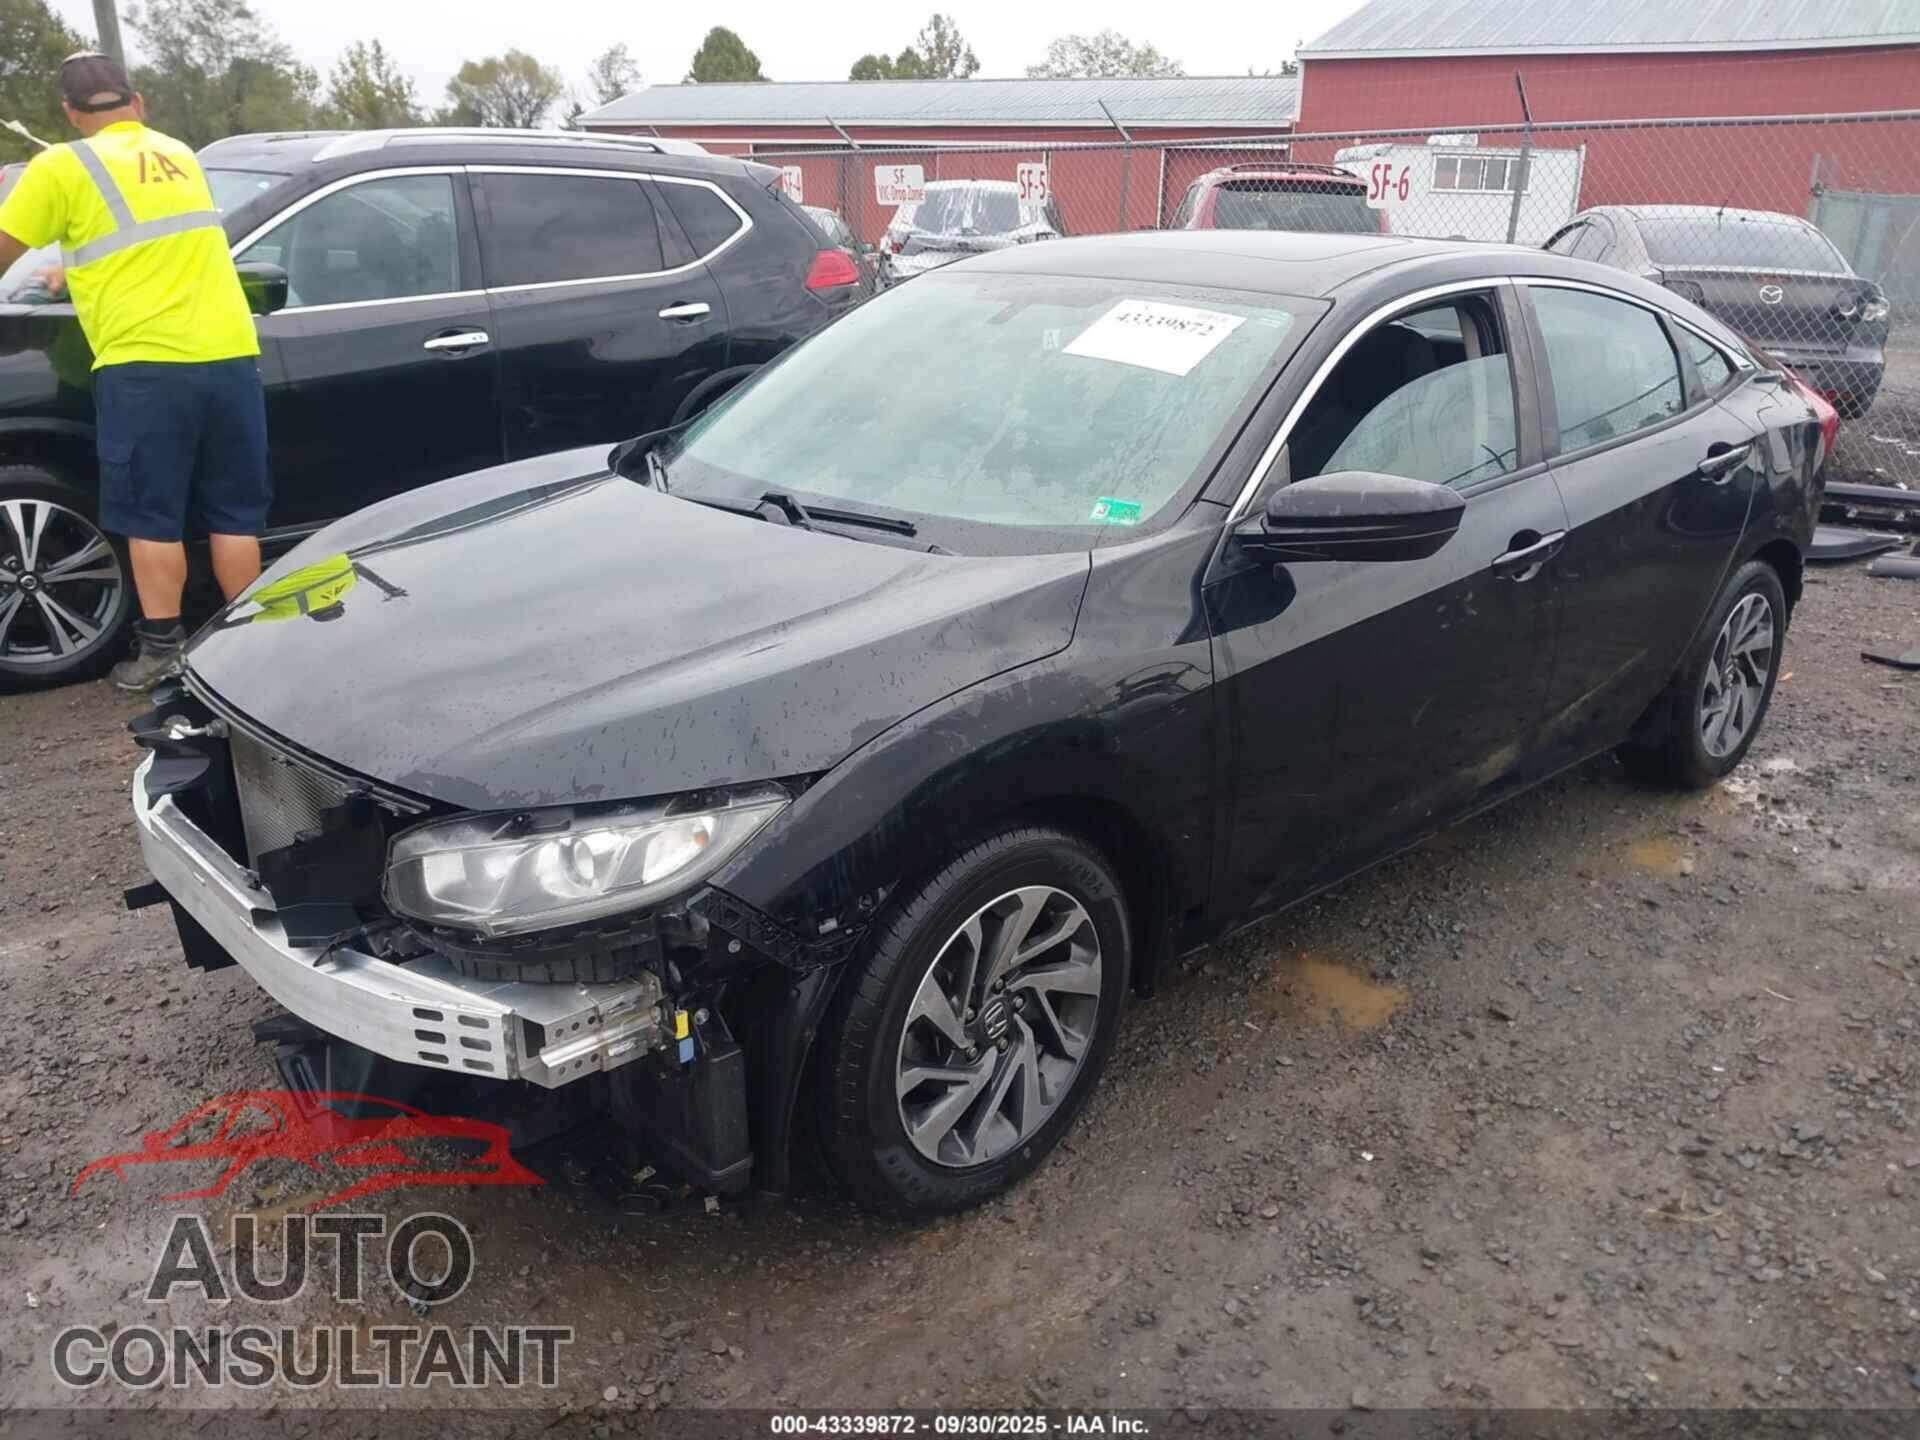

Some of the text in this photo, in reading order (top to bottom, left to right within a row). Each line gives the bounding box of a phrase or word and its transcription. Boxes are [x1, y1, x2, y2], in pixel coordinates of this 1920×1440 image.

[893, 168, 904, 184] SF
[1020, 169, 1046, 199] SF-5
[1370, 163, 1410, 201] SF-6
[1116, 312, 1215, 337] 43339872
